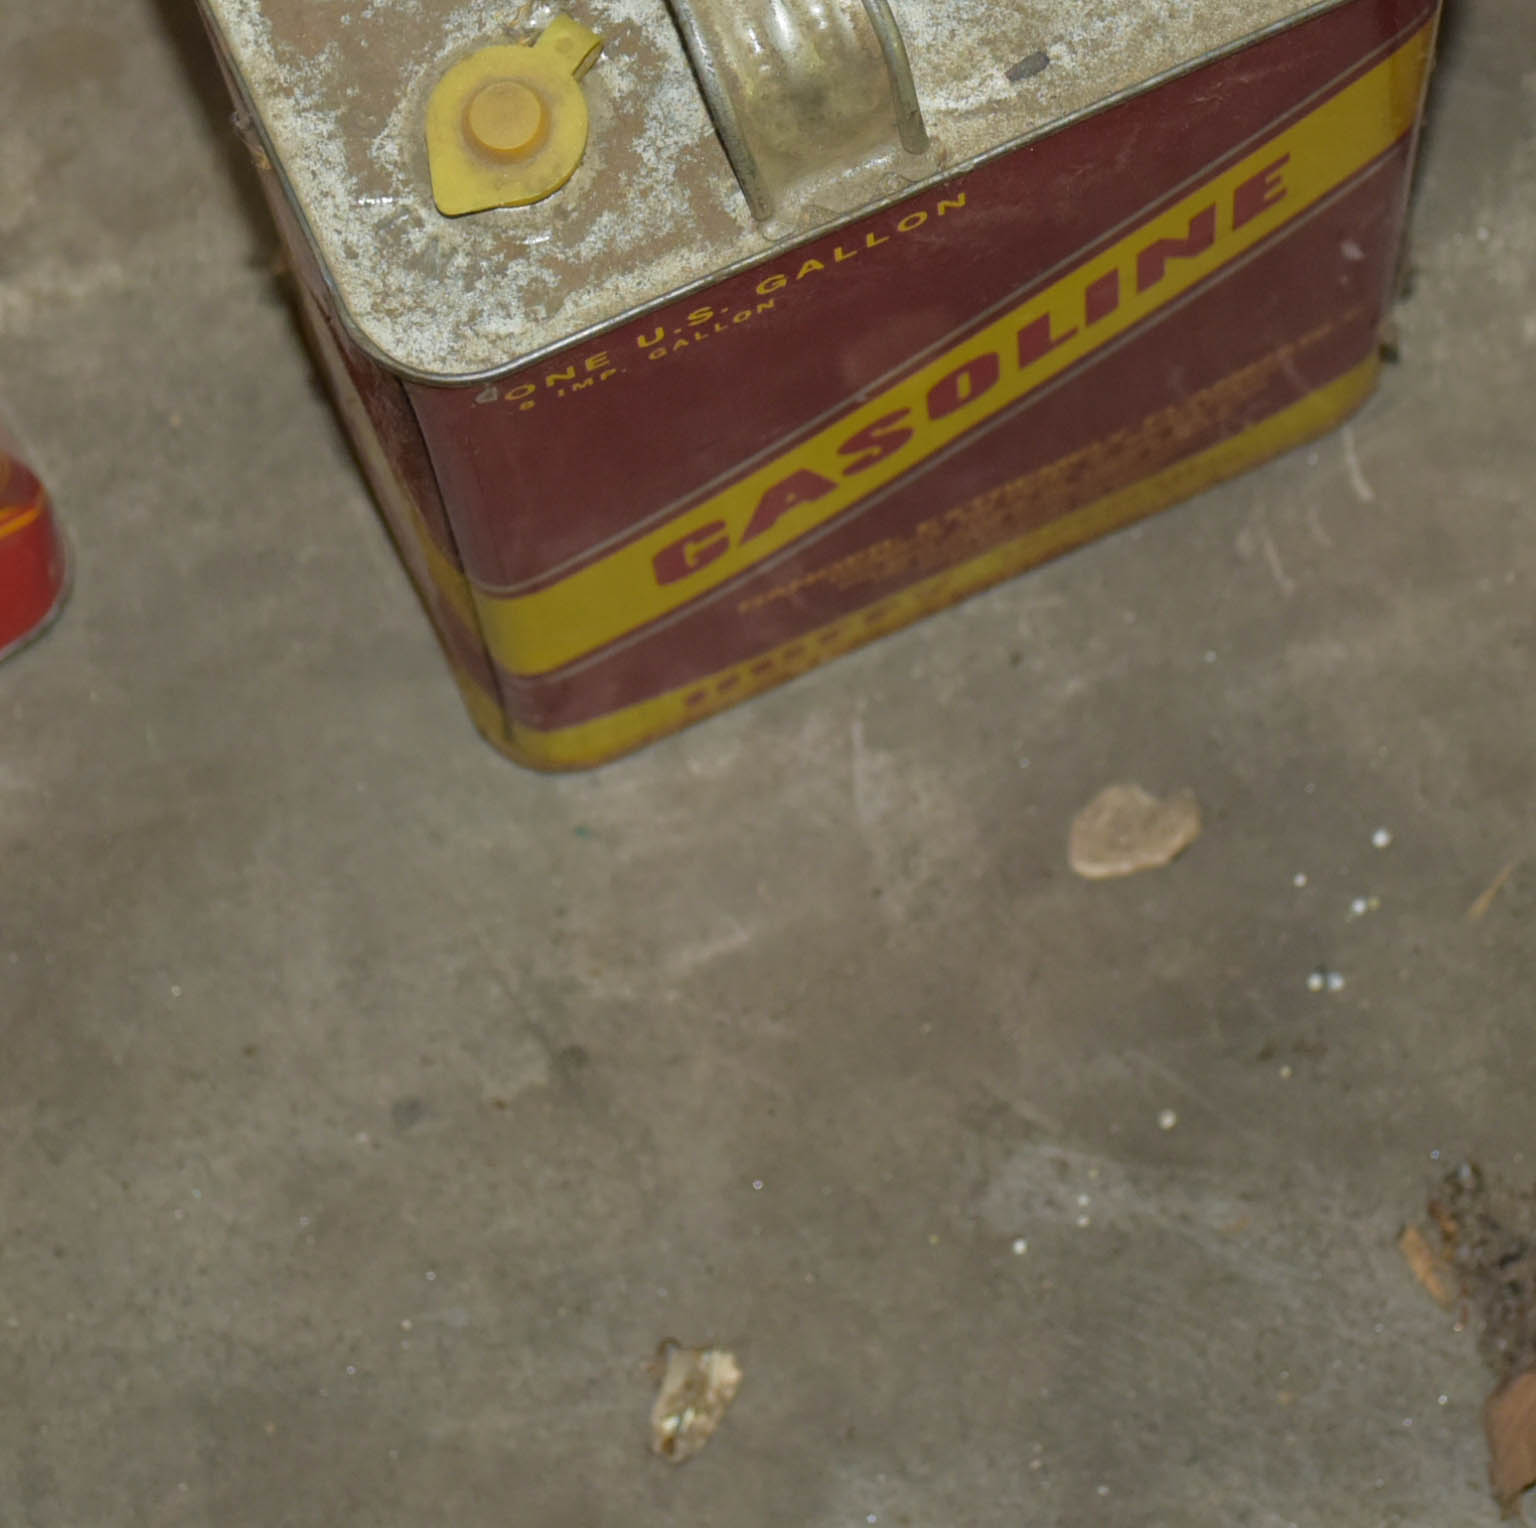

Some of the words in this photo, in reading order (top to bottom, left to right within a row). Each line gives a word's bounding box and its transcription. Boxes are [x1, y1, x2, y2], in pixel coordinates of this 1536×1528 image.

[504, 350, 611, 401] ONE
[637, 305, 729, 349] U.S.
[755, 191, 967, 295] GALLON
[648, 298, 775, 360] GALLON
[648, 152, 1290, 589] GASOLINE
